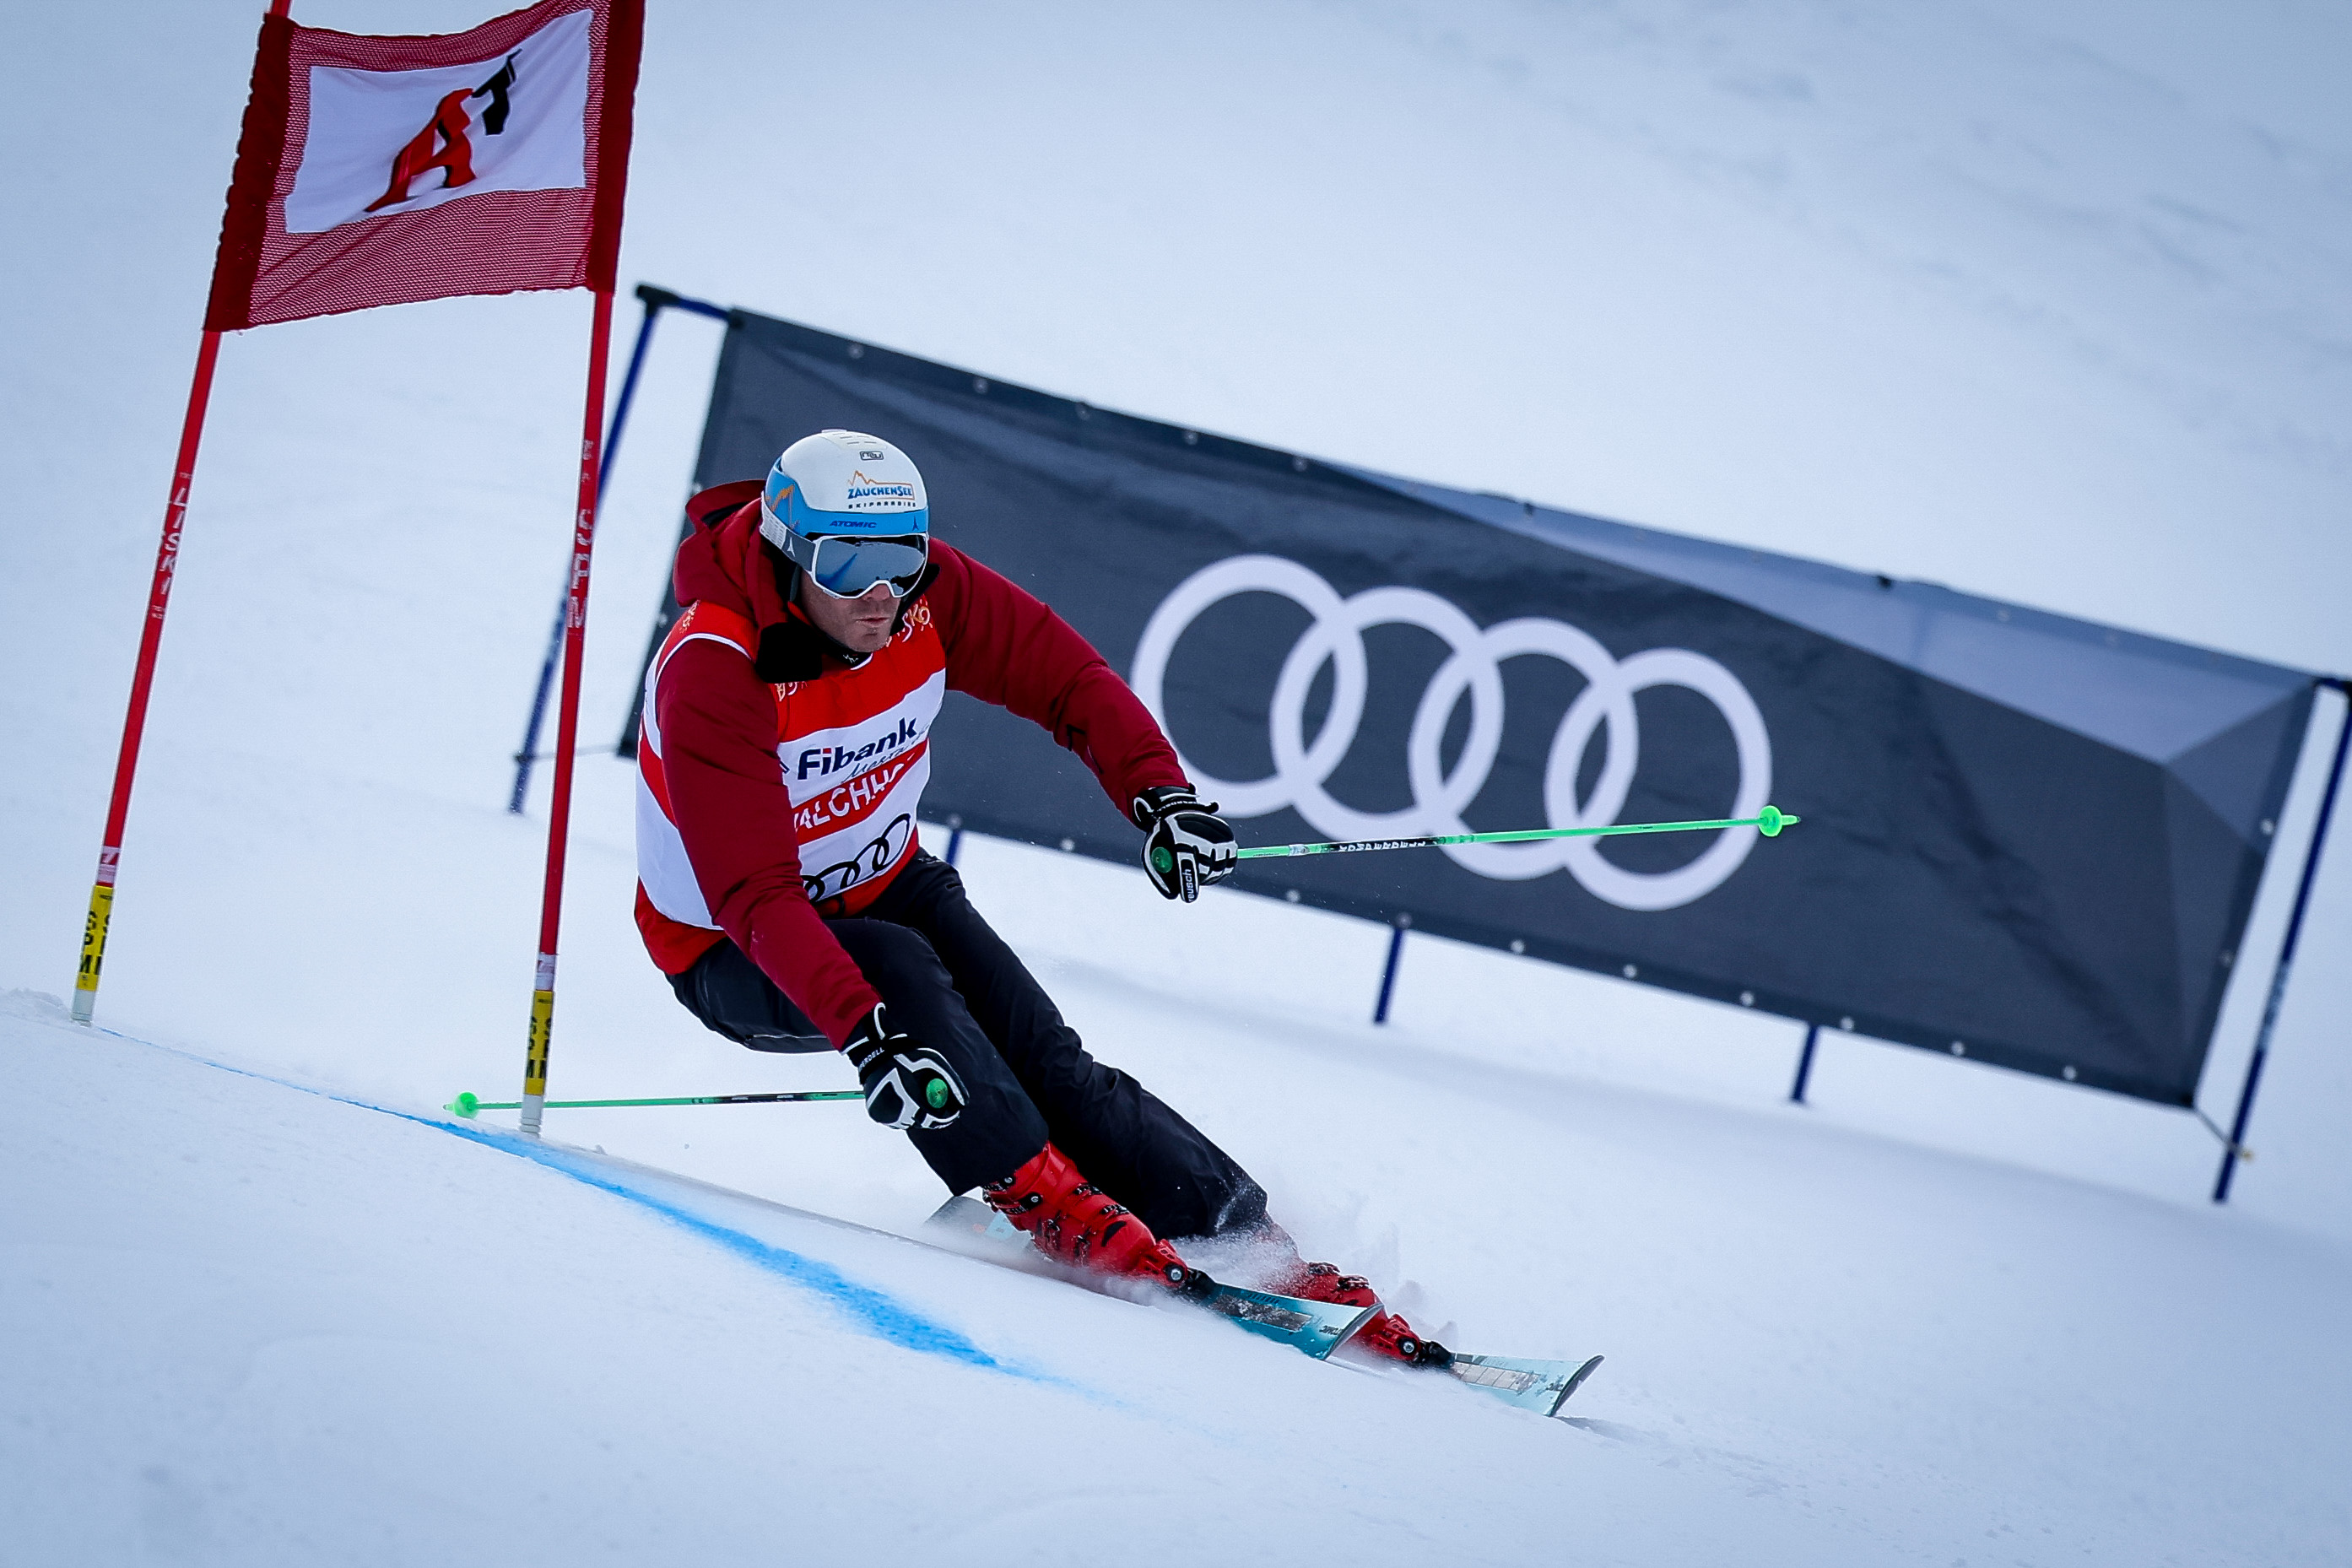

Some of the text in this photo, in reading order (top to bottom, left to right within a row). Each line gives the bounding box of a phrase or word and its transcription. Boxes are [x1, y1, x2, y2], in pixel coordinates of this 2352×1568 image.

[829, 520, 877, 529] ATOMIC
[797, 717, 917, 781] Fibank
[1182, 868, 1195, 902] reusch
